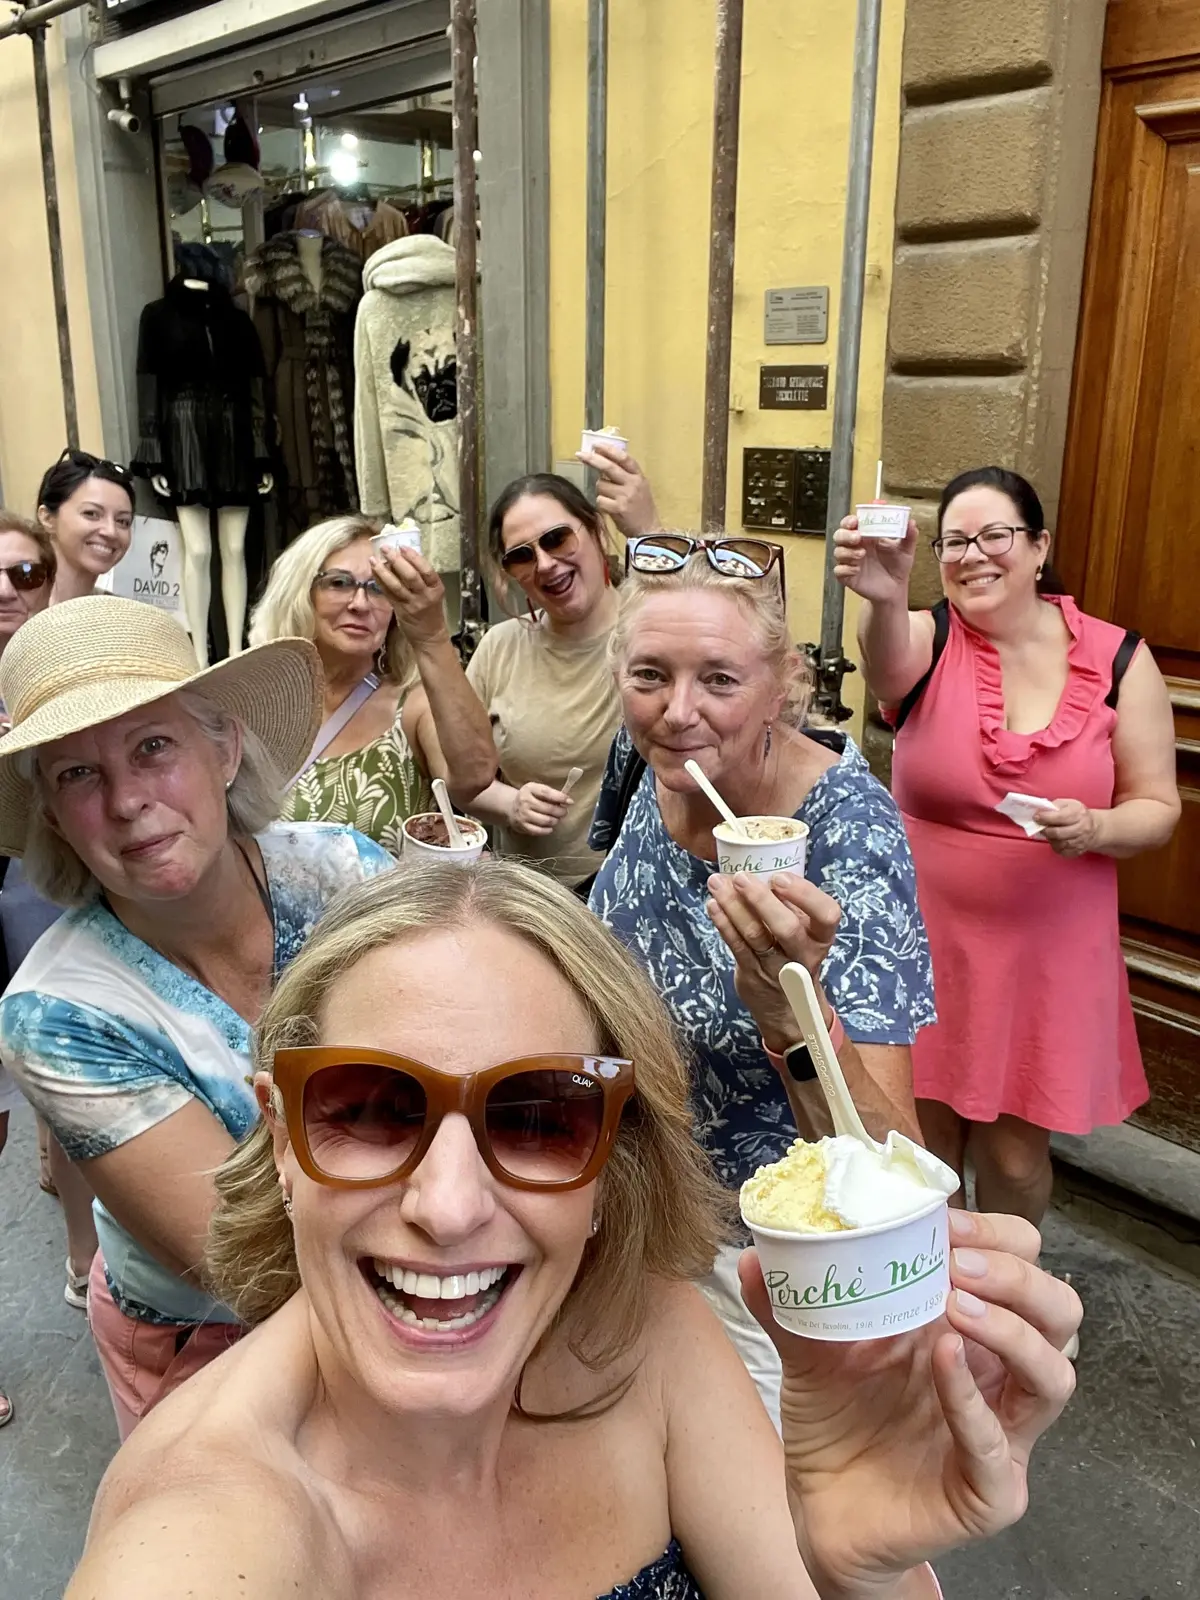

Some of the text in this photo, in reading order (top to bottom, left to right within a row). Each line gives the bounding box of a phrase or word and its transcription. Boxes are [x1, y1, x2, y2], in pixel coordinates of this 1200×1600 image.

[133, 578, 181, 597] DAVID 2
[807, 1033, 836, 1097] COMPOSTABLE
[572, 1074, 594, 1088] QUAY
[765, 1263, 867, 1306] Perchè
[881, 1306, 920, 1327] Firenze
